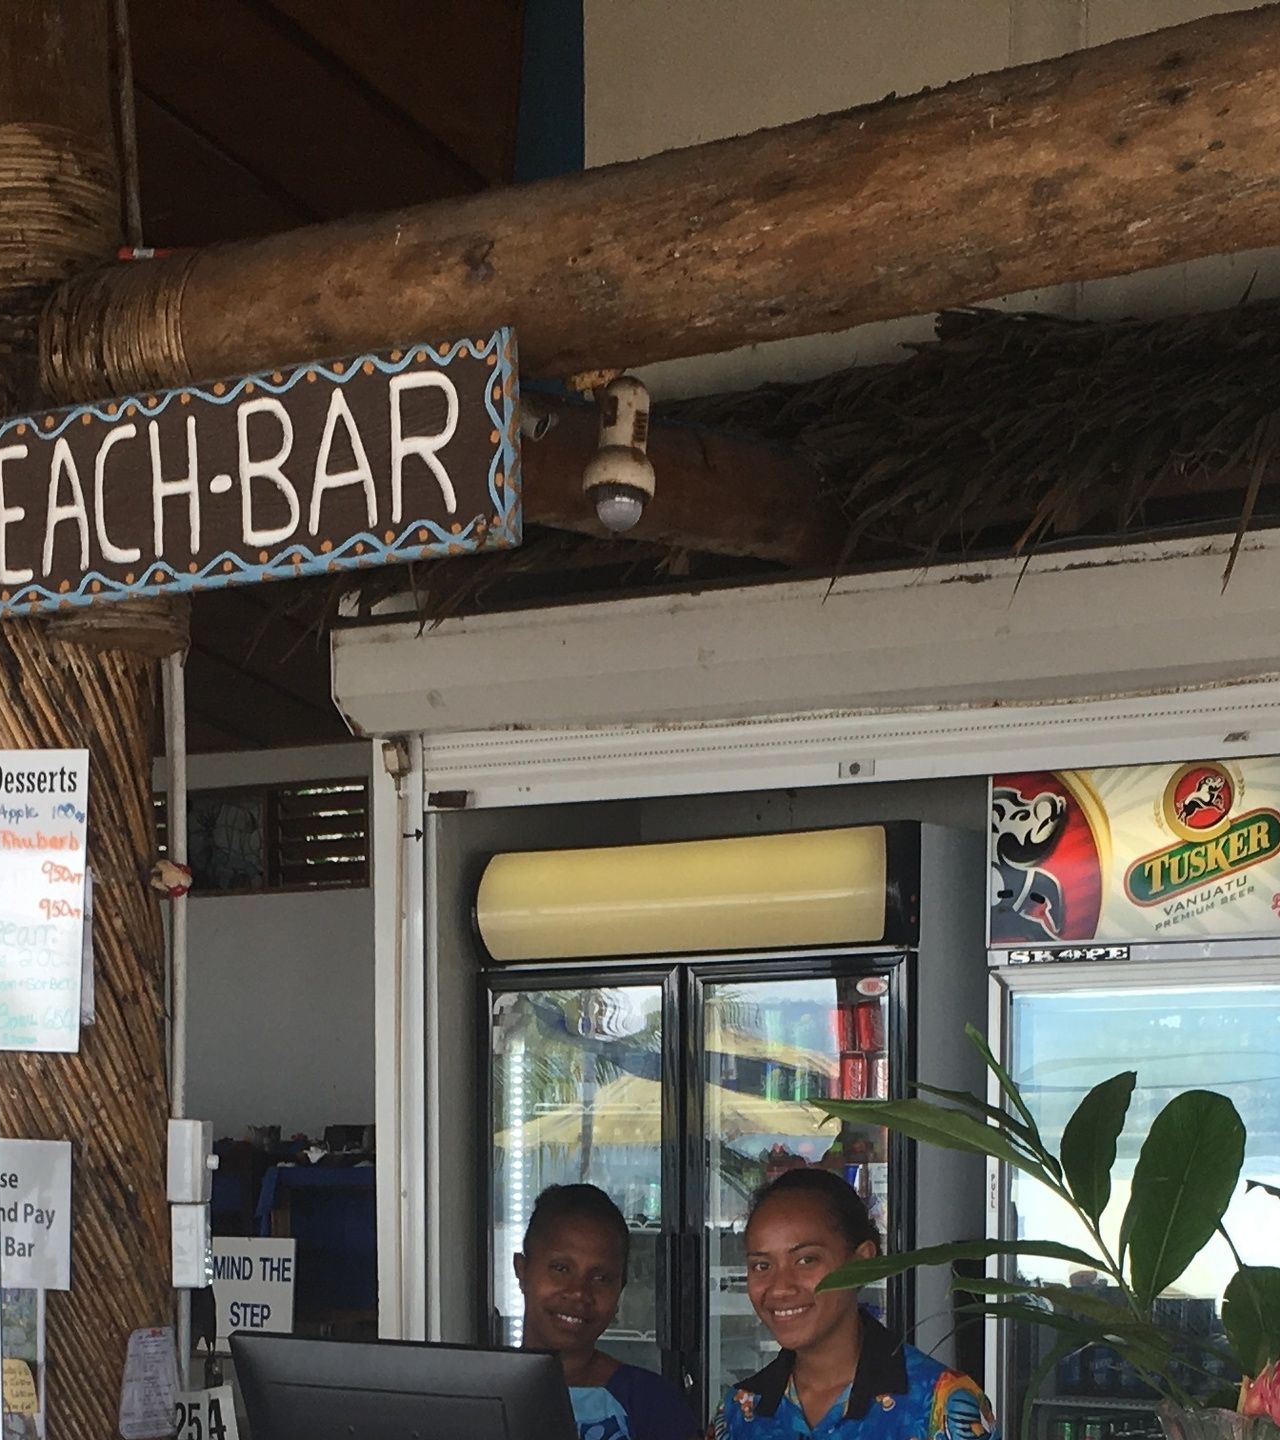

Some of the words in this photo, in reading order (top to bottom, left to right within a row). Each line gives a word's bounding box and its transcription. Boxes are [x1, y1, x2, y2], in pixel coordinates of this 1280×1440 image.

[1144, 819, 1271, 896] TUSKER
[1154, 902, 1216, 932] PREMIUM
[1220, 885, 1256, 906] BEER
[1163, 875, 1248, 917] VANUATU
[0, 1200, 19, 1223] nd
[23, 1202, 56, 1231] Pay
[4, 1235, 36, 1258] Bar
[213, 1255, 254, 1281] MIND
[259, 1256, 292, 1283] THE
[228, 1300, 272, 1329] STEP
